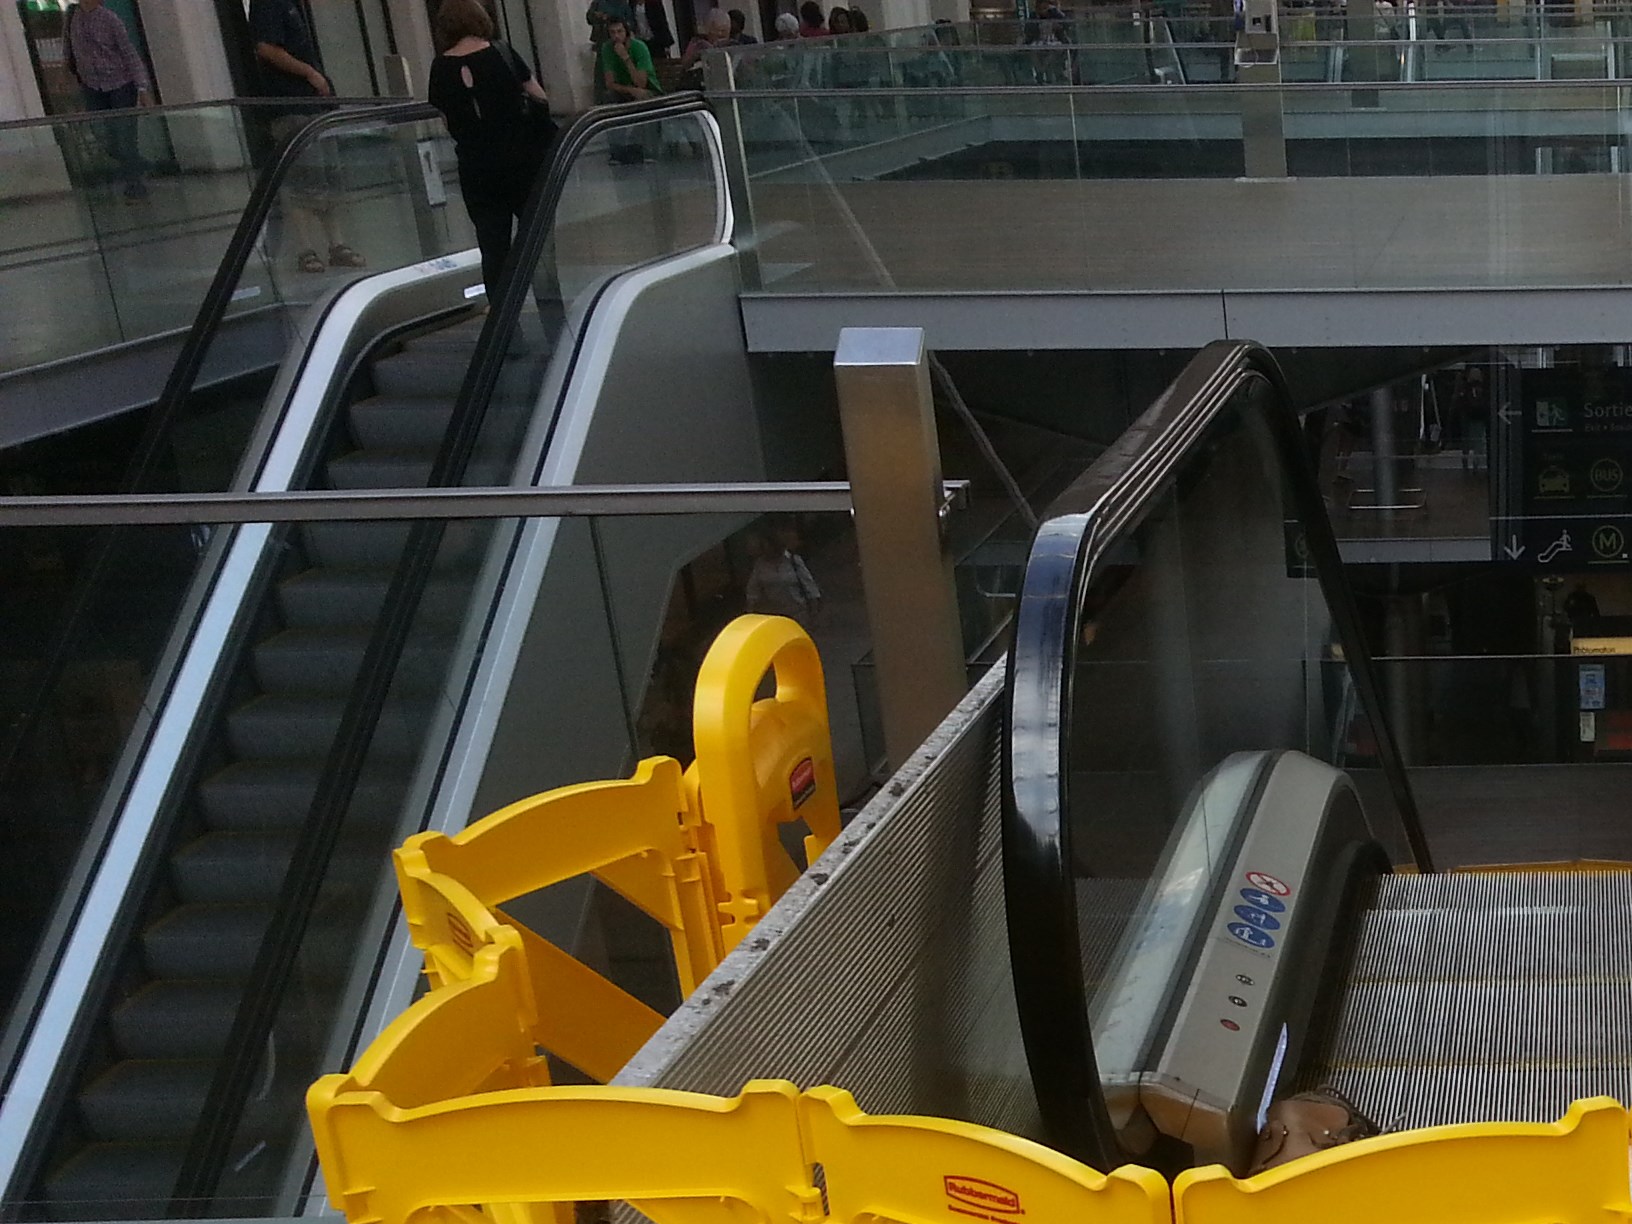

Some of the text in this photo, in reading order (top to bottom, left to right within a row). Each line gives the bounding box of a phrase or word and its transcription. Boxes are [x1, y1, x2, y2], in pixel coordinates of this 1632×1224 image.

[1594, 468, 1619, 481] BUS
[1599, 533, 1617, 550] M
[948, 1181, 1015, 1207] Rubbermaid
